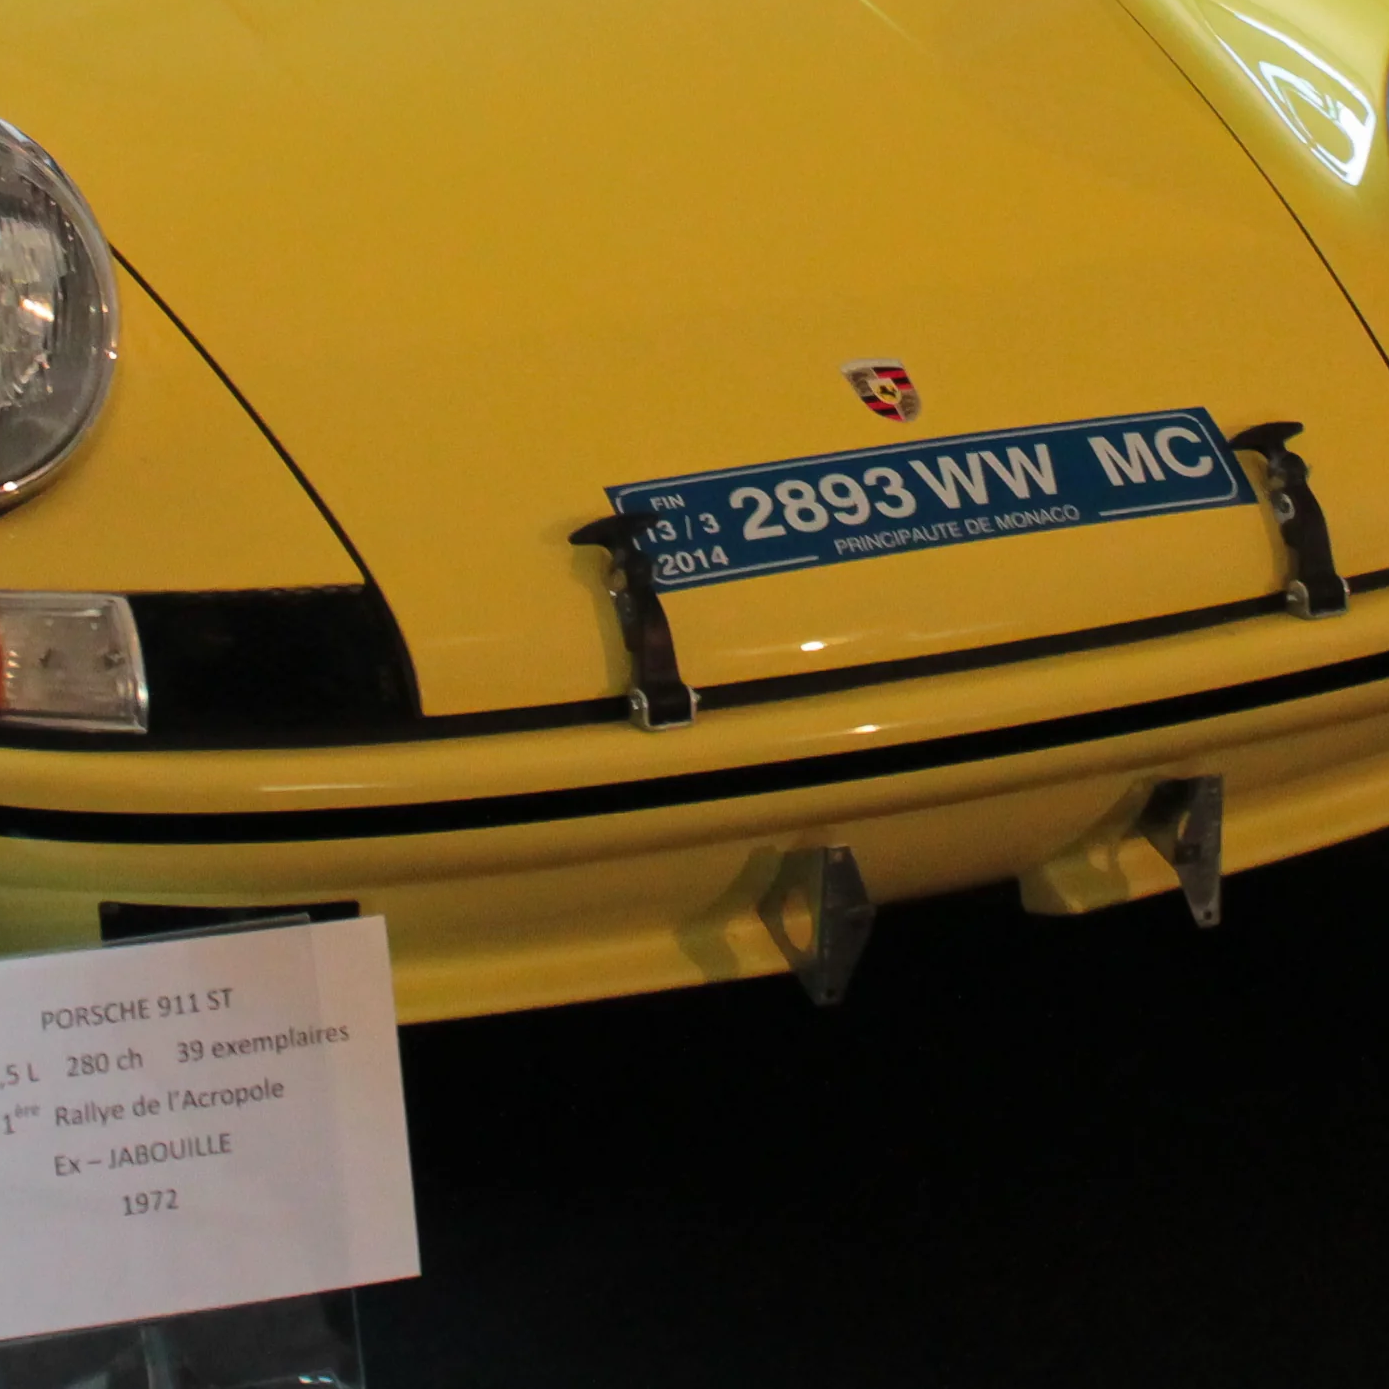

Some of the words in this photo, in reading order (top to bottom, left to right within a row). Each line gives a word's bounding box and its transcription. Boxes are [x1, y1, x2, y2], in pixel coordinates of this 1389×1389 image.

[1087, 426, 1214, 487] MC
[650, 493, 685, 511] FIN
[833, 520, 963, 556] PRINCIPAUTE
[964, 514, 994, 535] DE
[993, 503, 1081, 532] MONACO
[657, 545, 729, 576] 2014
[40, 998, 151, 1031] PORSCHE
[157, 992, 201, 1018] 911
[206, 987, 235, 1011] ST
[26, 1062, 40, 1083] L
[66, 1052, 110, 1078] 280
[116, 1047, 144, 1071] ch
[177, 1039, 204, 1064] 39
[211, 1024, 350, 1059] exemplaires
[54, 1100, 125, 1127] Rallye
[131, 1094, 161, 1118] de
[53, 1154, 82, 1177] Ex
[108, 1132, 233, 1171] JABOUILLE
[122, 1188, 180, 1217] 1972
